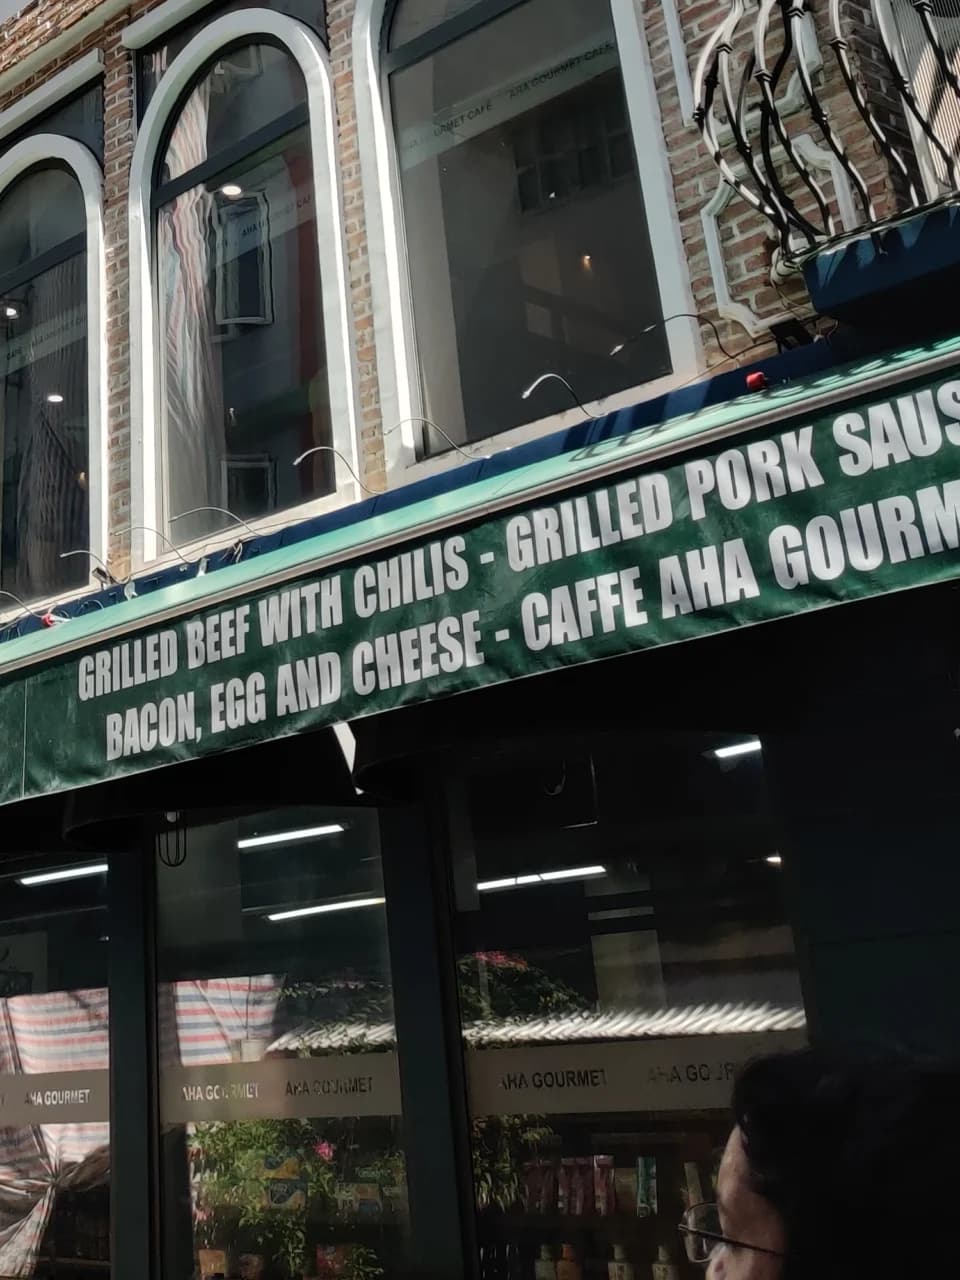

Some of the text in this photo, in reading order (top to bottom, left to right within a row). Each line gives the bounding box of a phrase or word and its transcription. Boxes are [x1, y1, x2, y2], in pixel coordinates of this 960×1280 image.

[78, 629, 178, 701] GRILLED
[187, 604, 250, 670] BEEF
[258, 575, 343, 647] WITH
[354, 535, 469, 618] CHILIS
[506, 473, 673, 572] GRILLED
[684, 425, 825, 521] PORK
[106, 691, 202, 761] BACON,
[210, 672, 266, 733] EGG
[277, 652, 341, 716] AND
[352, 610, 484, 696] CHEESE
[521, 566, 648, 651] CAFFE
[658, 538, 760, 619] AHA
[768, 480, 960, 590] GOURM
[25, 1088, 90, 1106] AHA GOURMET
[531, 1069, 607, 1089] GOURMET
